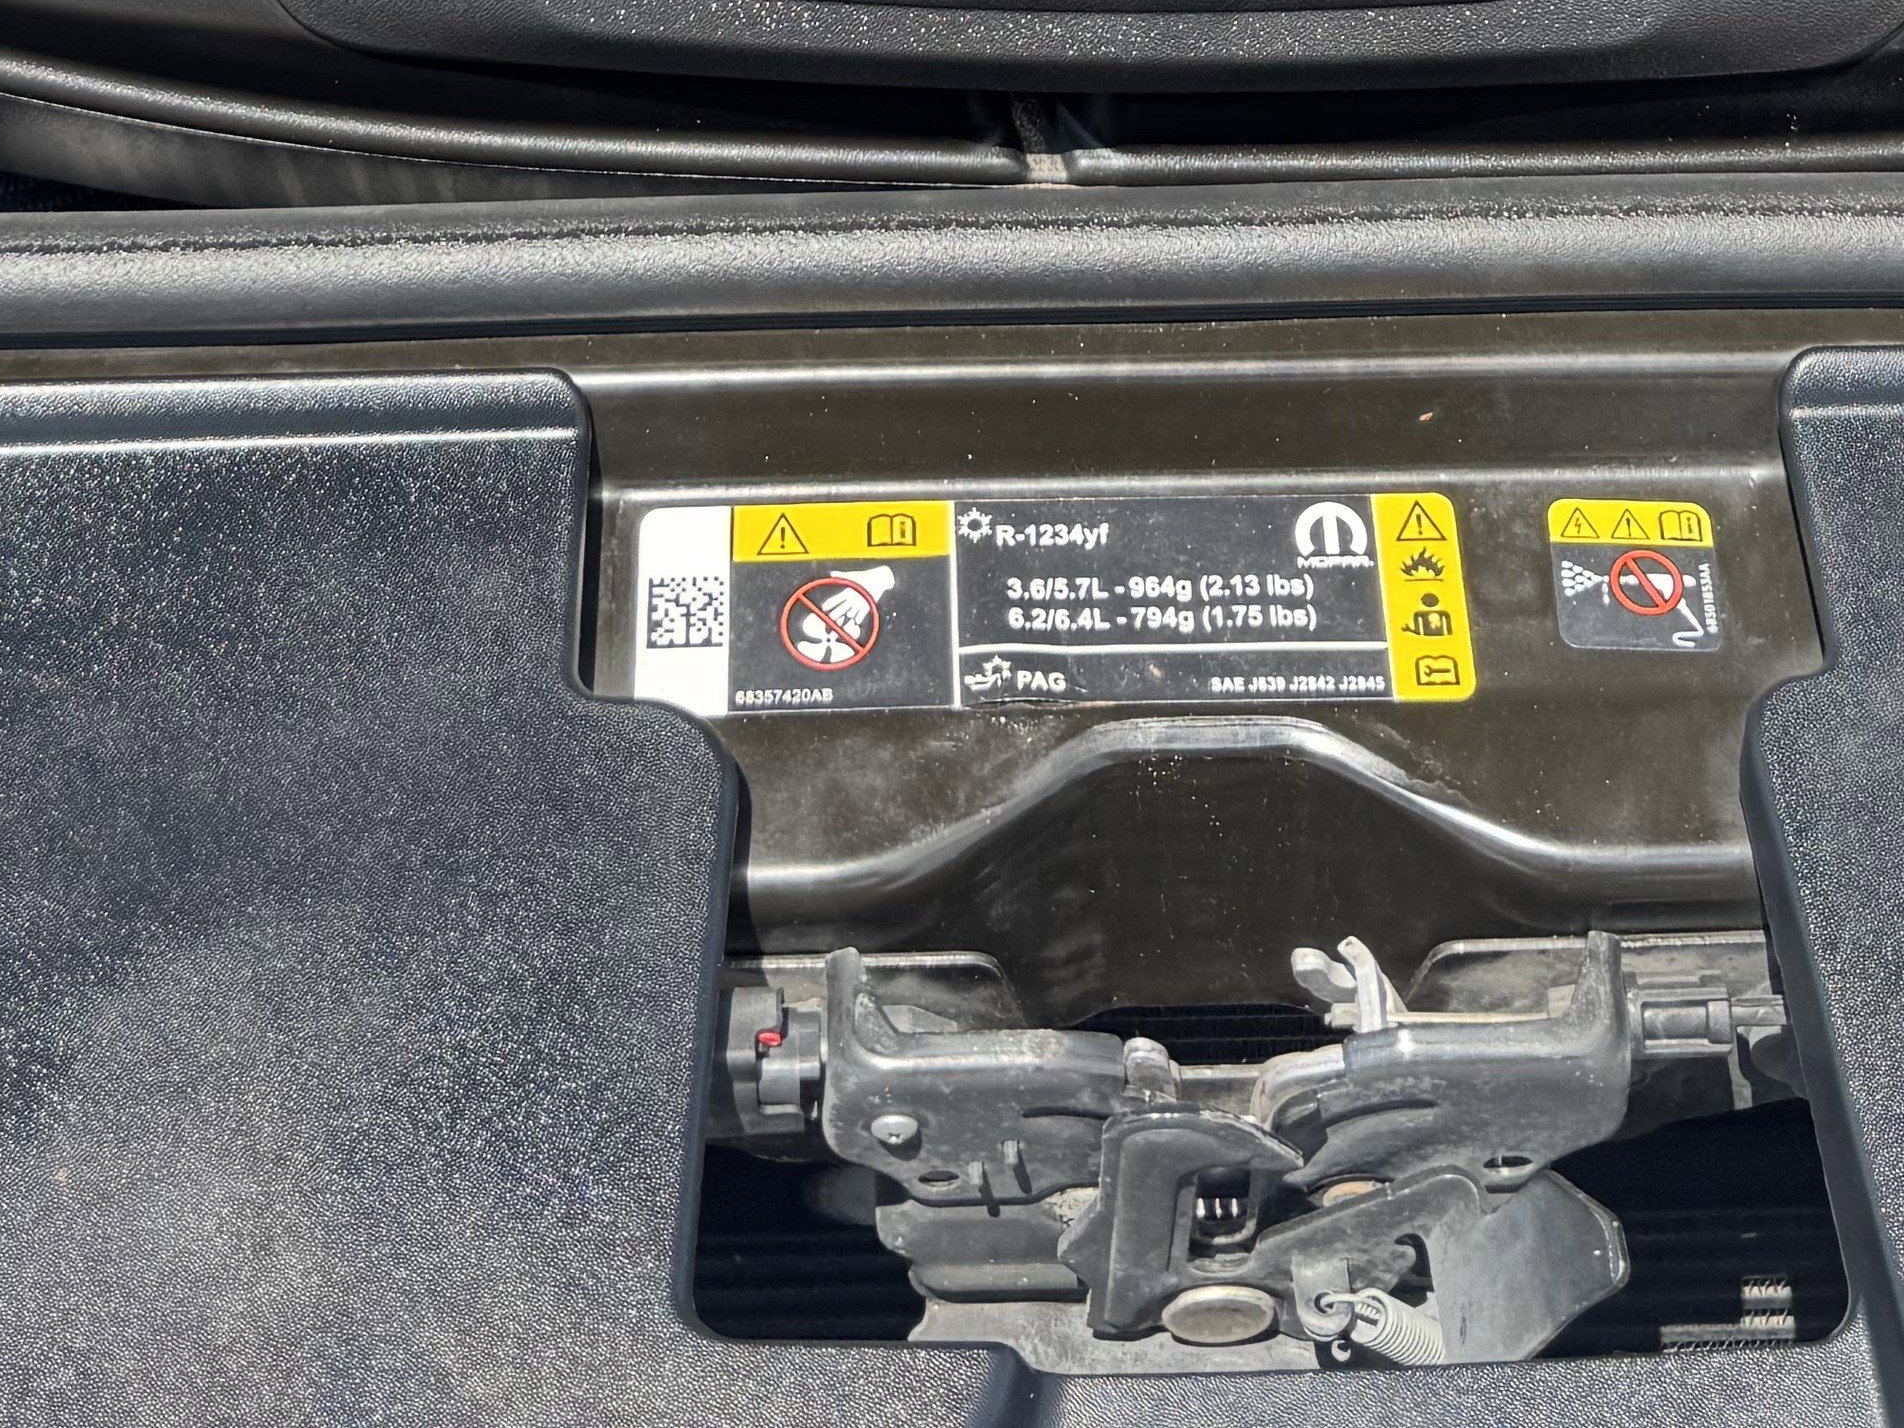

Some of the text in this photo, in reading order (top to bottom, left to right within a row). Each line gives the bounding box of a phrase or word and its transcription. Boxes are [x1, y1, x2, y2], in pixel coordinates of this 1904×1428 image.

[995, 522, 1110, 550] R-1234yf
[1006, 577, 1110, 601] 3.6/5.7L
[1200, 574, 1260, 601] (2.13
[1266, 573, 1314, 600] lbs)
[1008, 607, 1111, 631] 6.2/6.4L
[1202, 605, 1263, 632] (1.75
[1269, 603, 1317, 631] lbs)
[1016, 670, 1067, 692] PAG
[1211, 676, 1245, 692] SAE
[1289, 674, 1335, 691] J2842
[735, 687, 833, 705] 68357420AB
